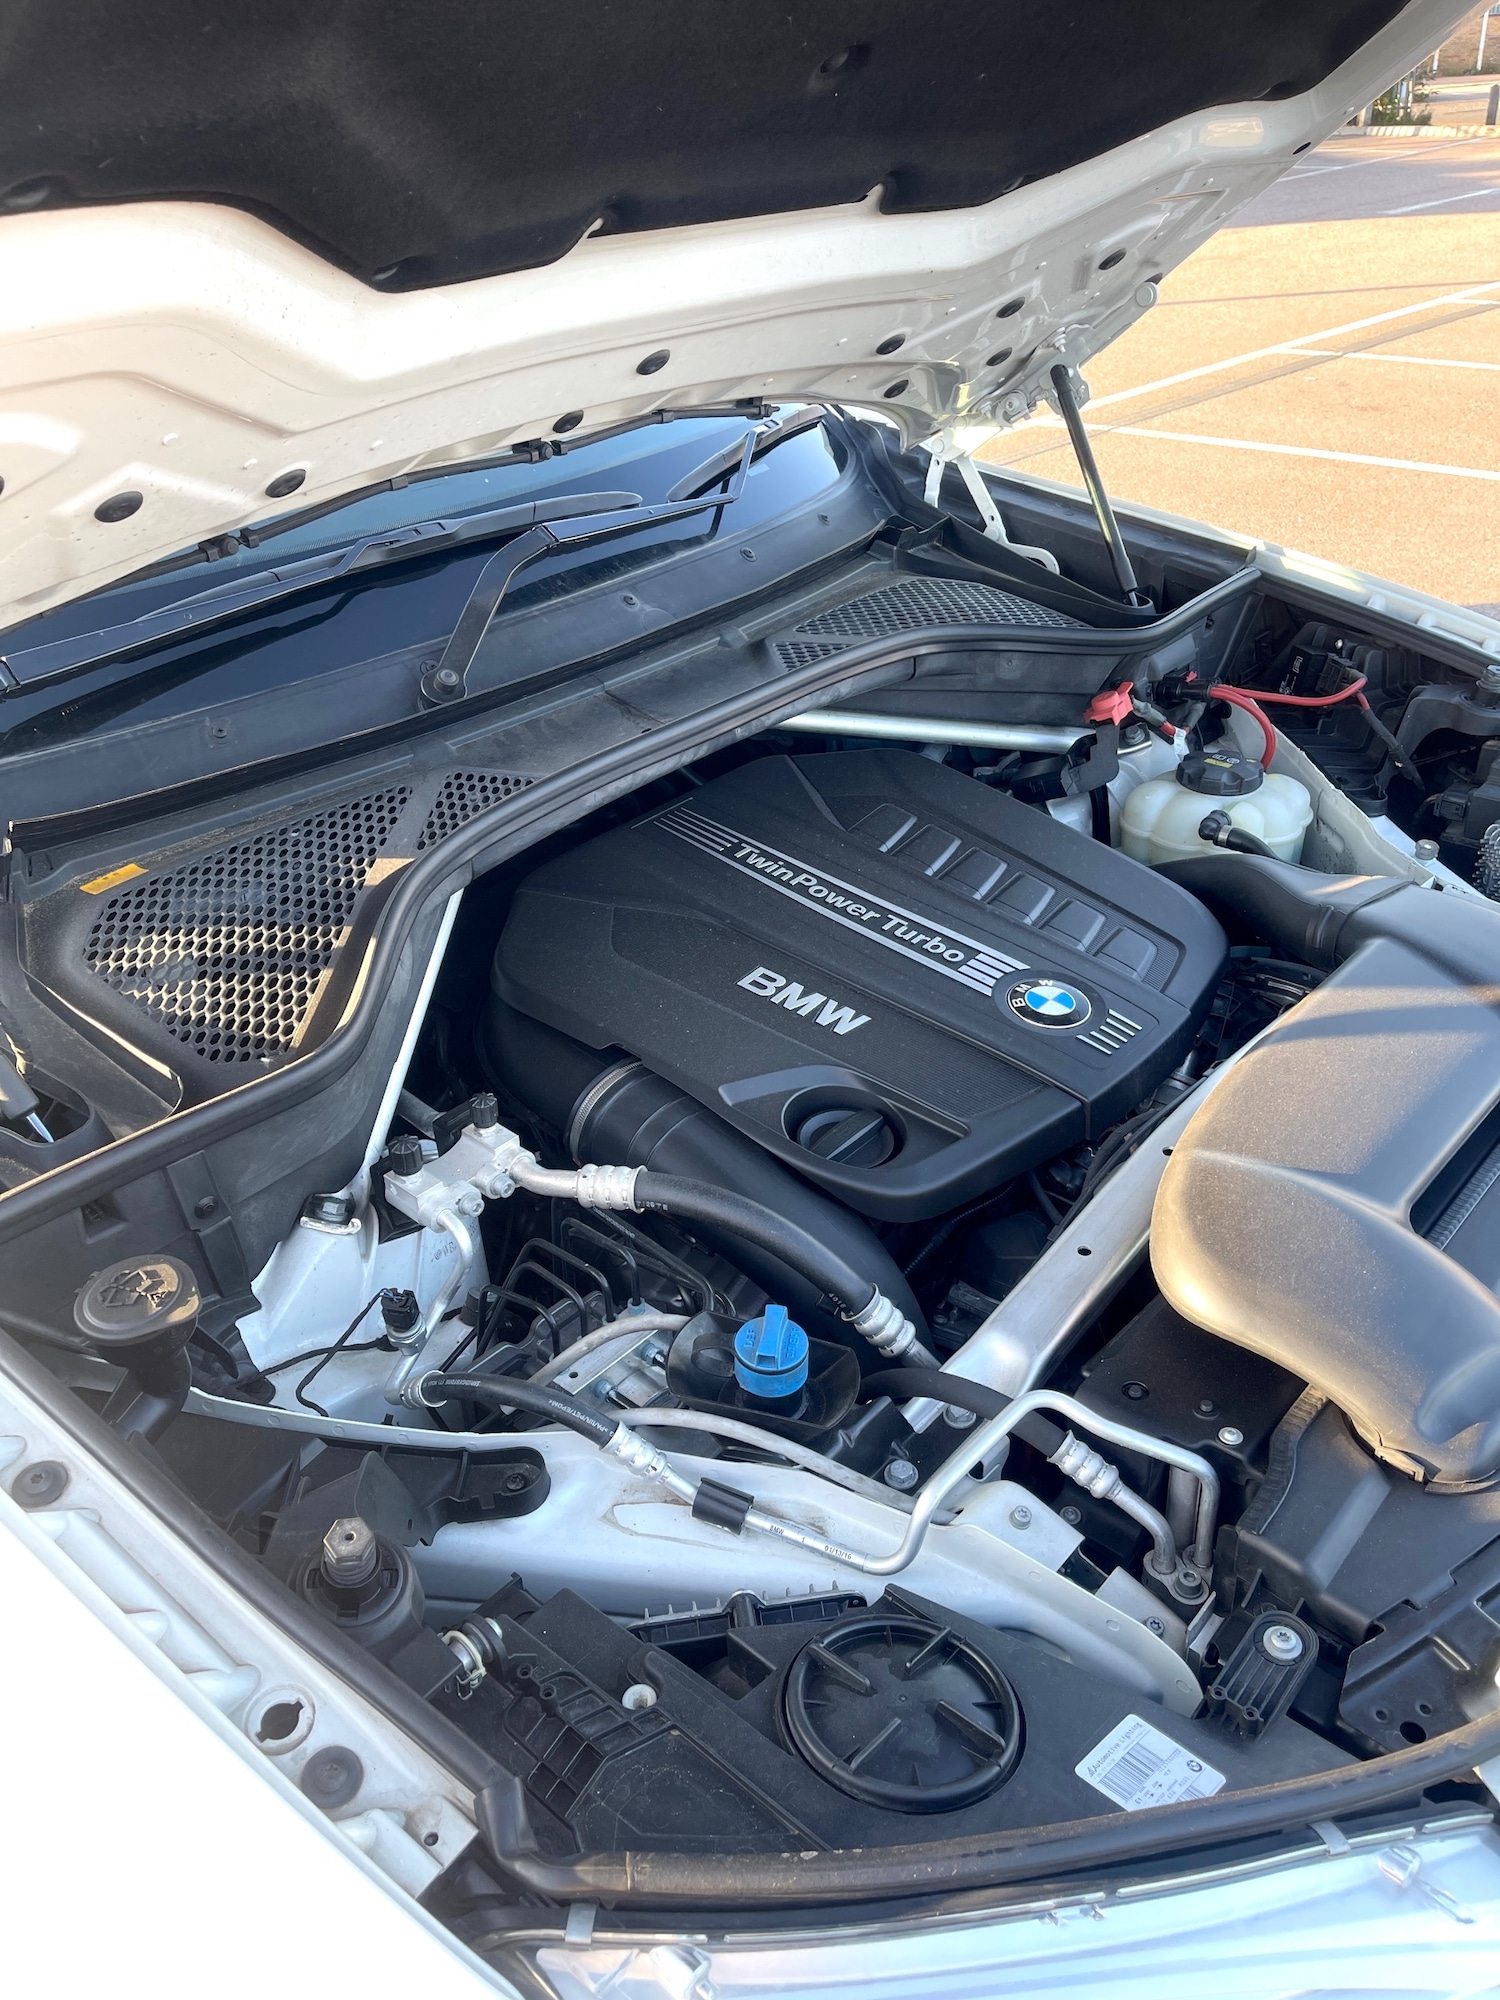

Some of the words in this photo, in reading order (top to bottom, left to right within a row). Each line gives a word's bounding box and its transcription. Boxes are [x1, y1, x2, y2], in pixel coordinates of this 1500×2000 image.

[733, 843, 881, 921] TwinPower
[880, 914, 965, 964] Turbo
[736, 966, 872, 1036] BMW
[1011, 979, 1054, 1008] BMW
[769, 1524, 785, 1536] BMW
[824, 1545, 852, 1560] 01/13/16
[1092, 1742, 1121, 1773] Automotive
[1119, 1722, 1144, 1745] Lighting
